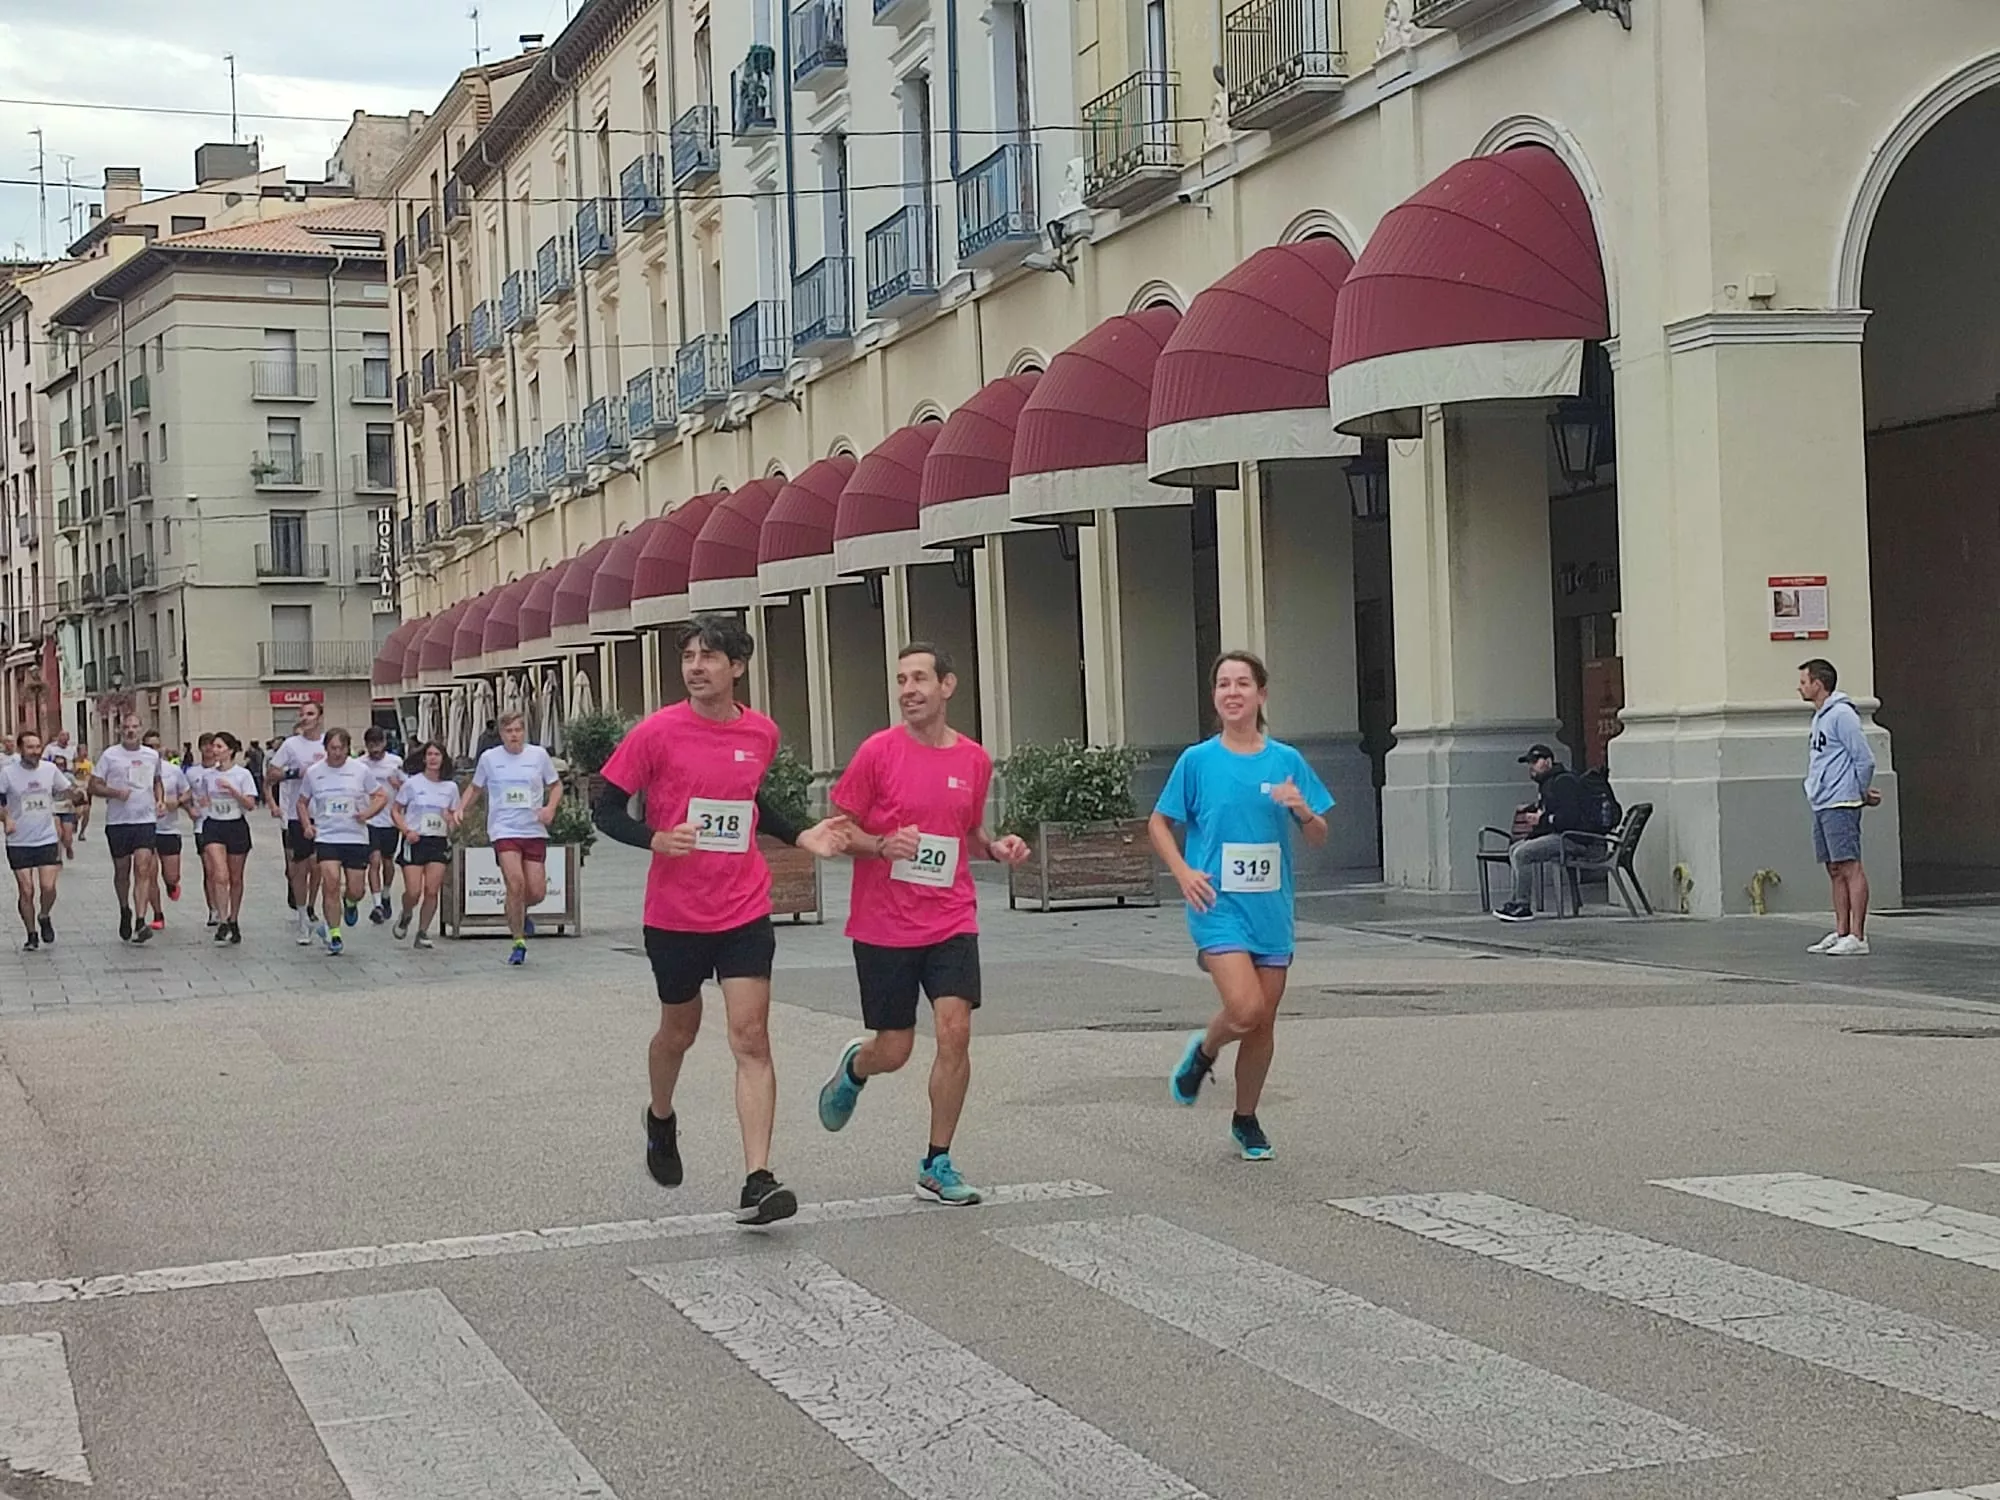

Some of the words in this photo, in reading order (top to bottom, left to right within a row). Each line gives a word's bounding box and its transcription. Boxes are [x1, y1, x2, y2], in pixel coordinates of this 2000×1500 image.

[379, 507, 391, 596] HOSTAL
[284, 692, 310, 702] GAES
[700, 813, 740, 831] 318
[1233, 859, 1271, 876] 319
